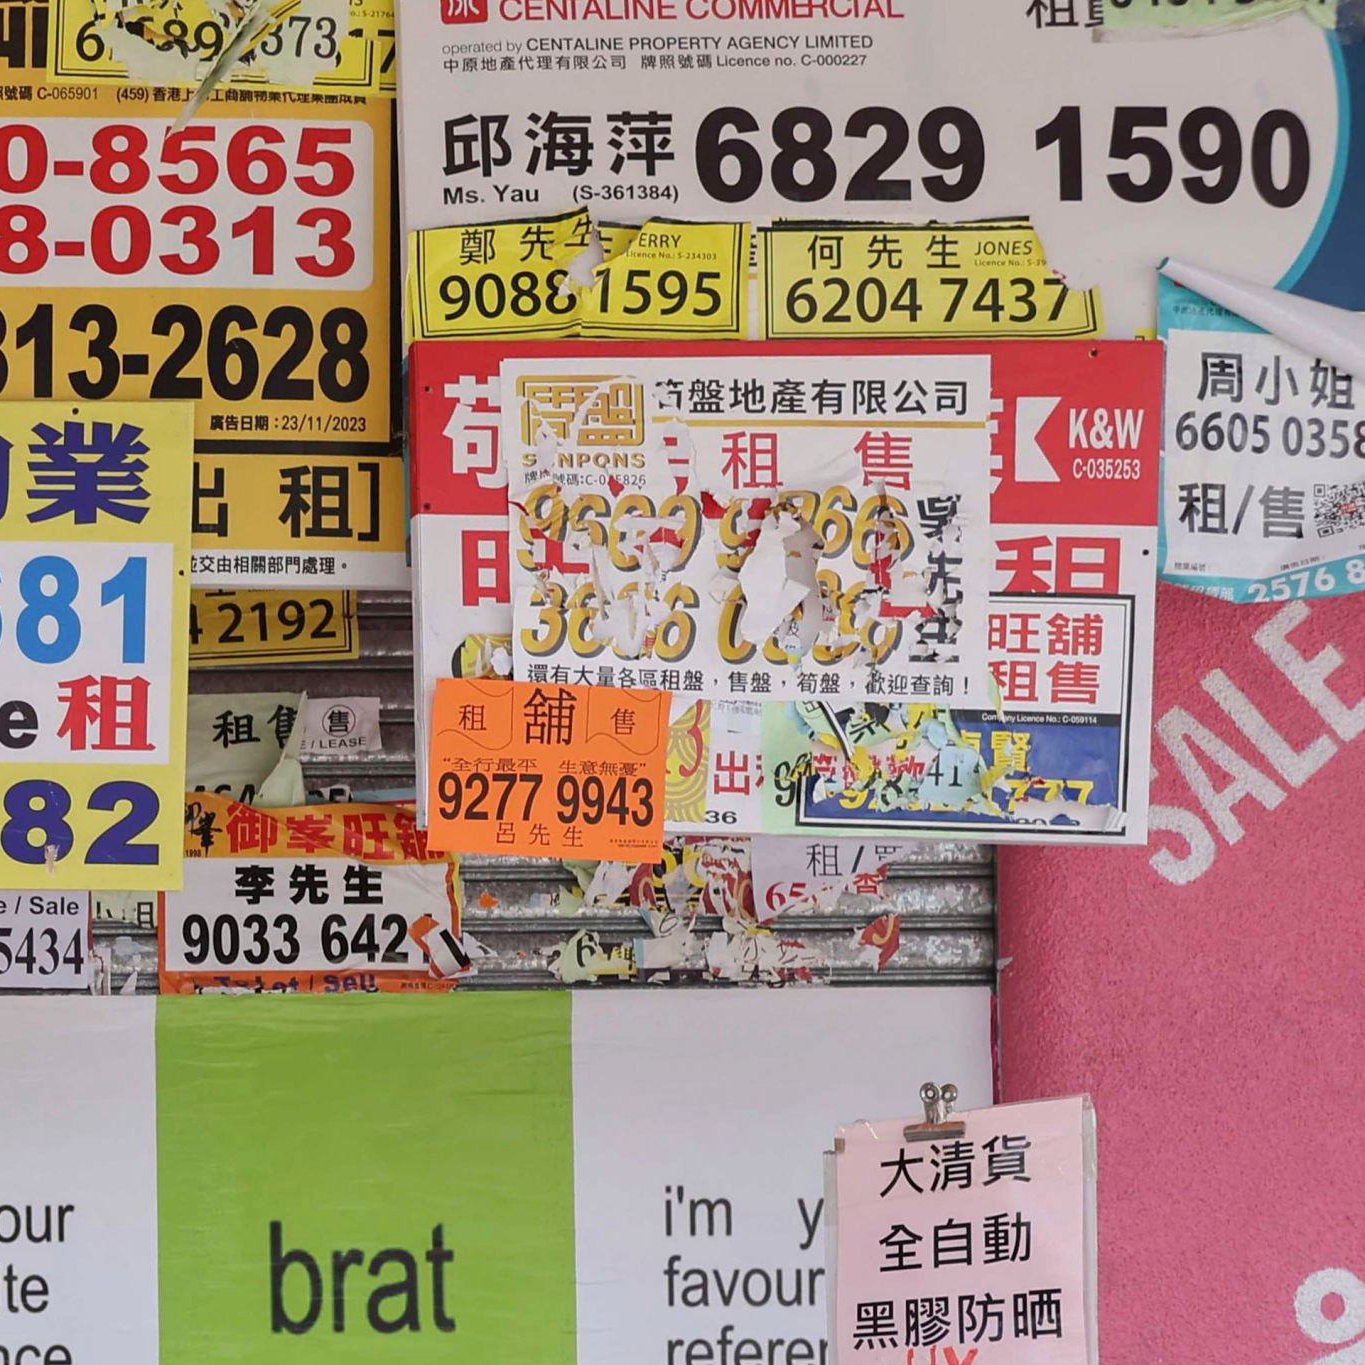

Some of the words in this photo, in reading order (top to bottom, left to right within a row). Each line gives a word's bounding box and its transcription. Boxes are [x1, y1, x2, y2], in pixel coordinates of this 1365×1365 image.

[441, 41, 502, 55] operated
[526, 37, 624, 52] CENTALINE
[628, 37, 722, 51] PROPERTY
[726, 36, 800, 50] AGENCY
[804, 35, 874, 49] LIMITED
[443, 55, 627, 73] 中原地產代理有限公司
[641, 54, 713, 70] 牌照號碼
[716, 54, 770, 69] Licence
[800, 54, 867, 67] C-000227
[37, 88, 99, 101] C-065901
[442, 111, 675, 179] 邱海萍
[695, 106, 986, 204] 6829
[1035, 105, 1311, 209] 1590
[443, 187, 485, 205] Ms.
[495, 186, 540, 203] Yau
[573, 184, 679, 203] (S-361384)
[808, 234, 961, 271] 何先生
[974, 240, 1033, 256] JONES
[439, 272, 576, 321] 9088
[595, 270, 723, 317] 1595
[785, 277, 923, 324] 6204
[941, 277, 1068, 323] 7437
[1196, 352, 1355, 410] 周小姐
[1070, 407, 1142, 451] K&W
[1176, 411, 1270, 454] 6605
[1282, 416, 1365, 459] 0358
[1072, 458, 1142, 481] C-035253
[56, 674, 157, 752] 租
[1146, 598, 1365, 884] SALE
[438, 775, 543, 822] 9277
[556, 779, 655, 826] 9943
[29, 896, 80, 917] Sale
[235, 864, 383, 905] 李先生
[182, 913, 300, 964] 9033
[879, 1136, 1033, 1198] 大清貨
[878, 1215, 1033, 1274] 全自動
[269, 1219, 456, 1335] brat
[852, 1288, 1063, 1351] 黑膠防晒
